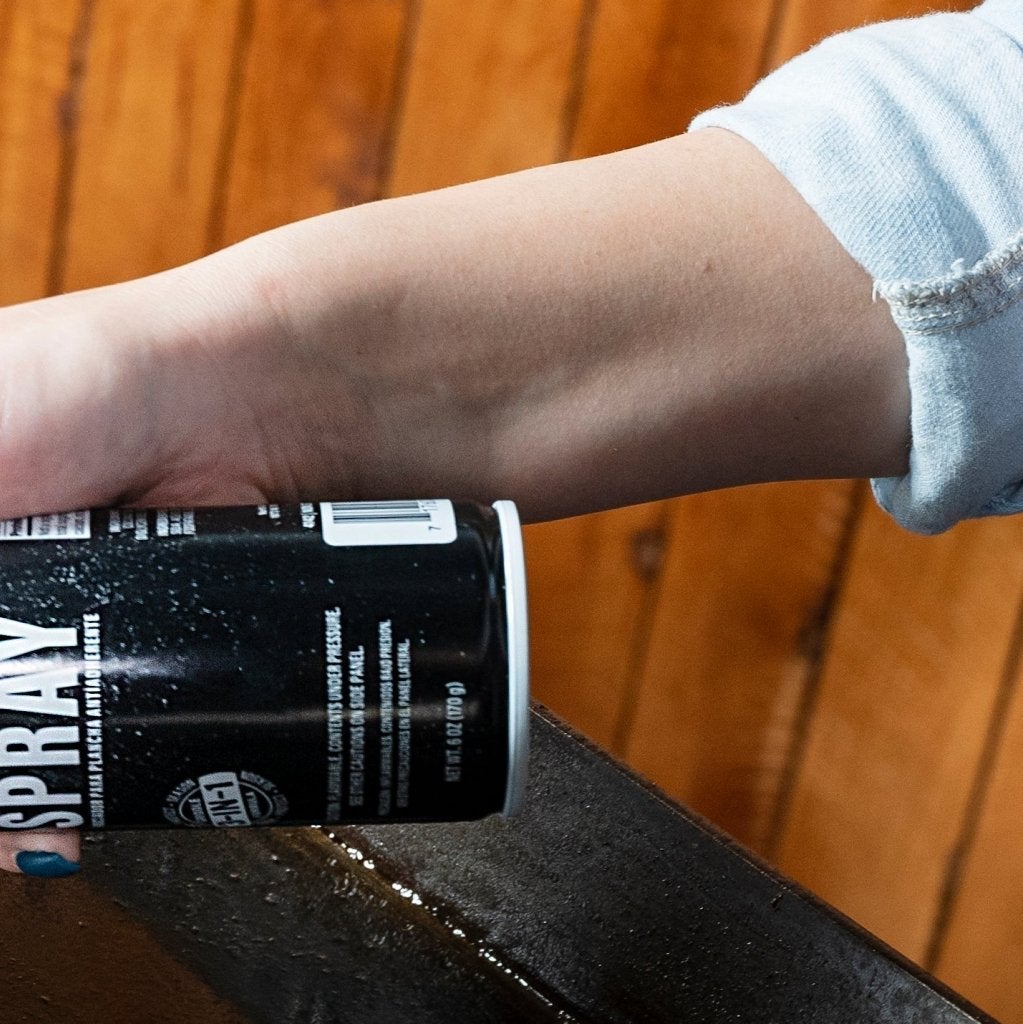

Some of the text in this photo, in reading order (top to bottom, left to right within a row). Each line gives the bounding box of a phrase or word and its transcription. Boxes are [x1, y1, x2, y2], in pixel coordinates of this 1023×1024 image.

[324, 605, 343, 664] PRESSURE.
[347, 645, 365, 684] PANEL.
[326, 664, 343, 702] UNDER
[348, 685, 366, 709] SIDE
[444, 681, 467, 696] g)
[444, 696, 466, 721] (170
[326, 702, 343, 752] CONTENTS
[445, 722, 463, 737] OZ
[445, 738, 463, 746] 6
[85, 719, 104, 772] PLANCHA
